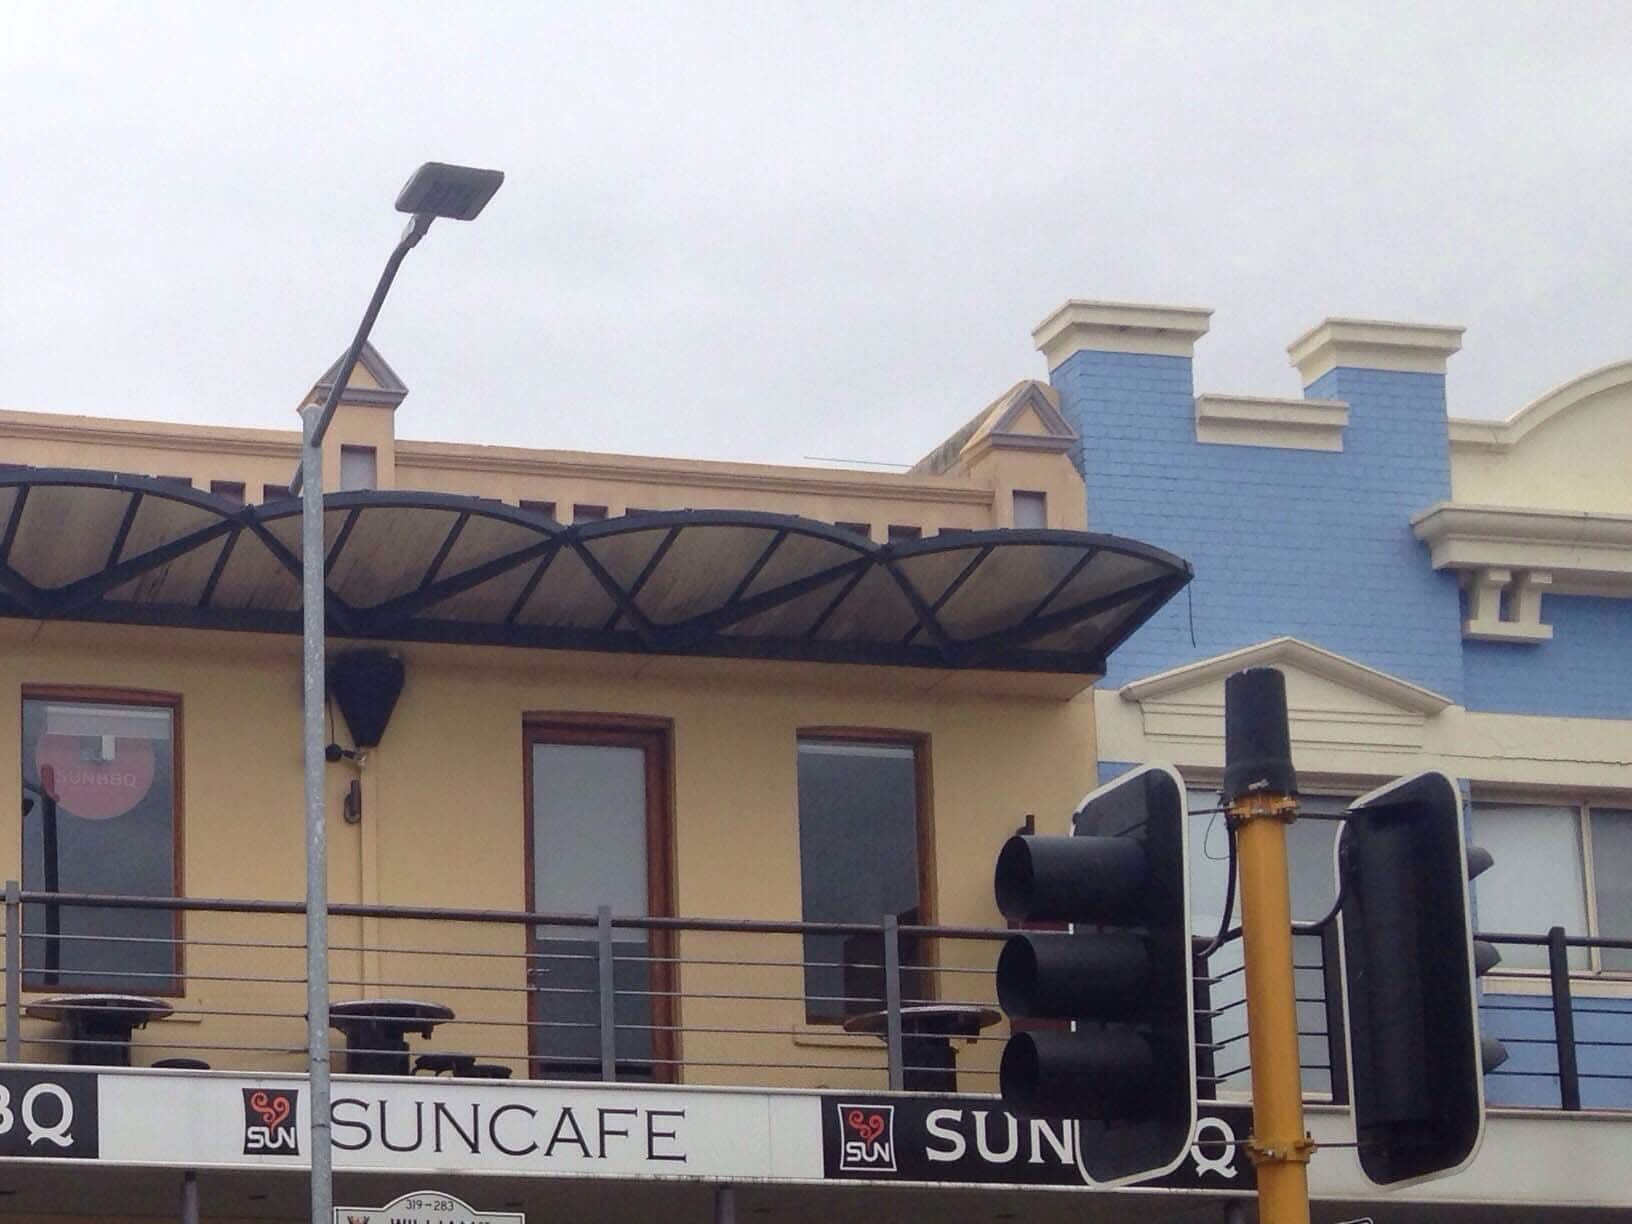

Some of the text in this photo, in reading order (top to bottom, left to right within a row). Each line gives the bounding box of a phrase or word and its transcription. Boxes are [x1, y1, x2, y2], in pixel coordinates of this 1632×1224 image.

[246, 1125, 297, 1149] SUN
[330, 1098, 688, 1164] SUNCAFE
[846, 1142, 890, 1163] SUN
[925, 1110, 1238, 1178] SUNQ
